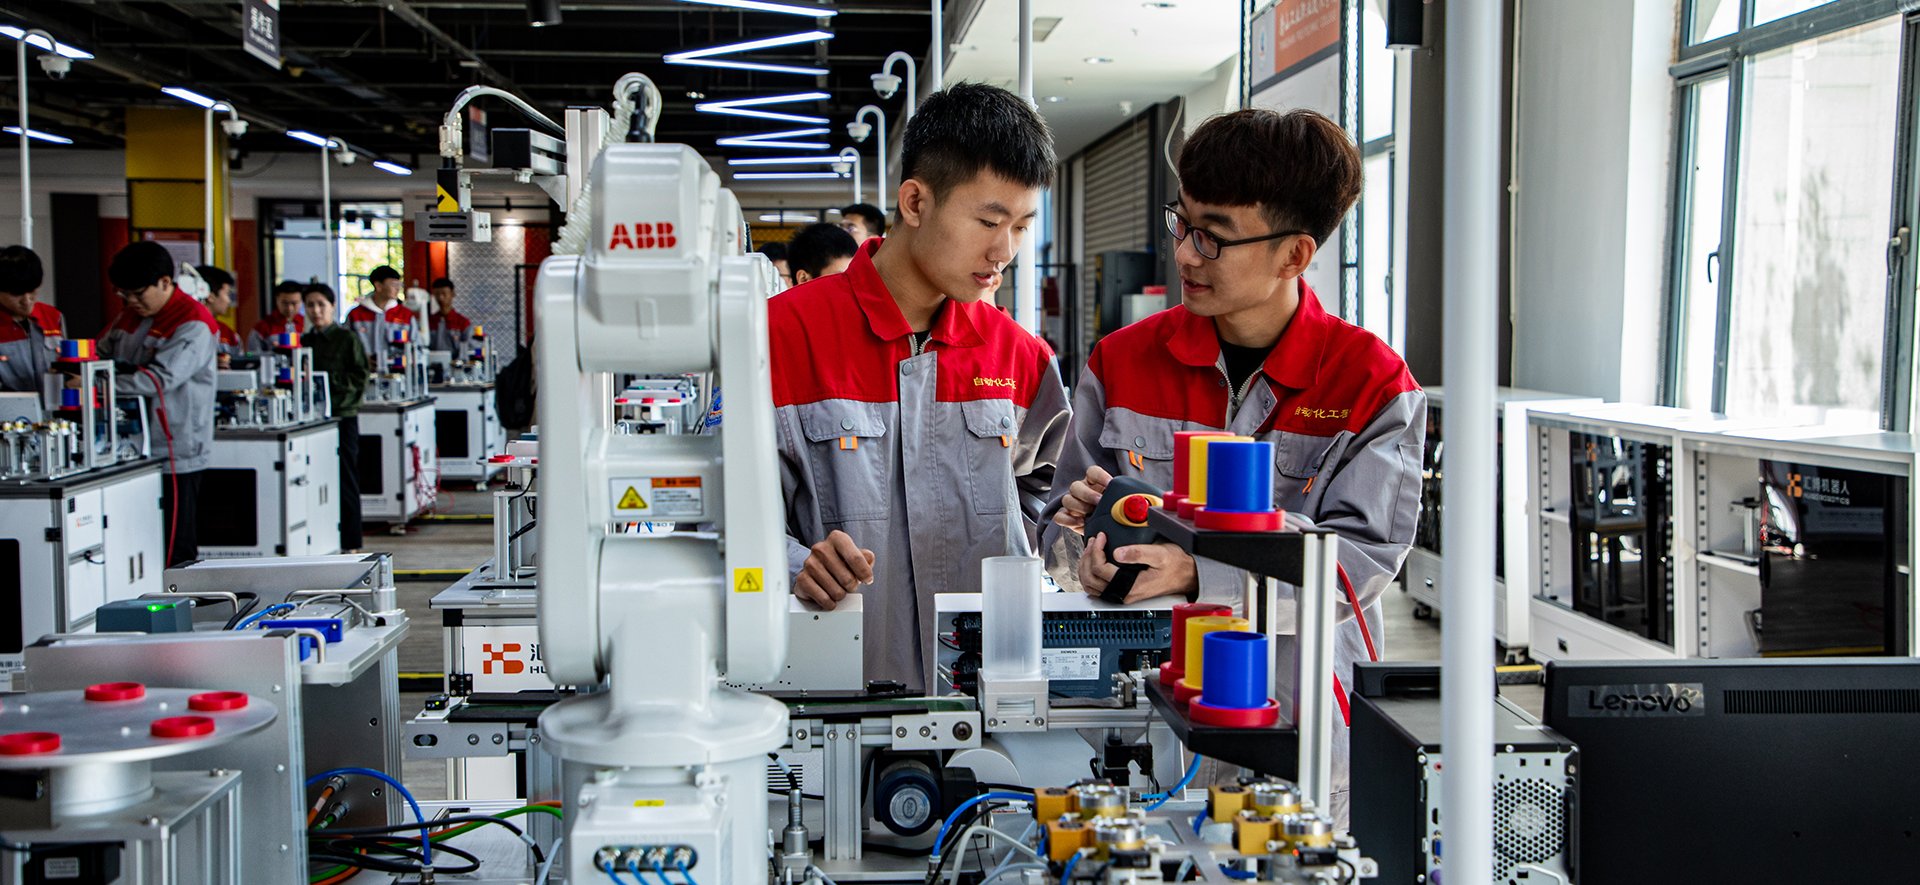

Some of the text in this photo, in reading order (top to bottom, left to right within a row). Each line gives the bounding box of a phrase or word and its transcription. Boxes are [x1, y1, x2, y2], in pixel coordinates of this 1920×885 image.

[609, 222, 677, 250] ABB
[1295, 405, 1352, 419] 自动化工程
[1588, 690, 1691, 713] Lenovo
